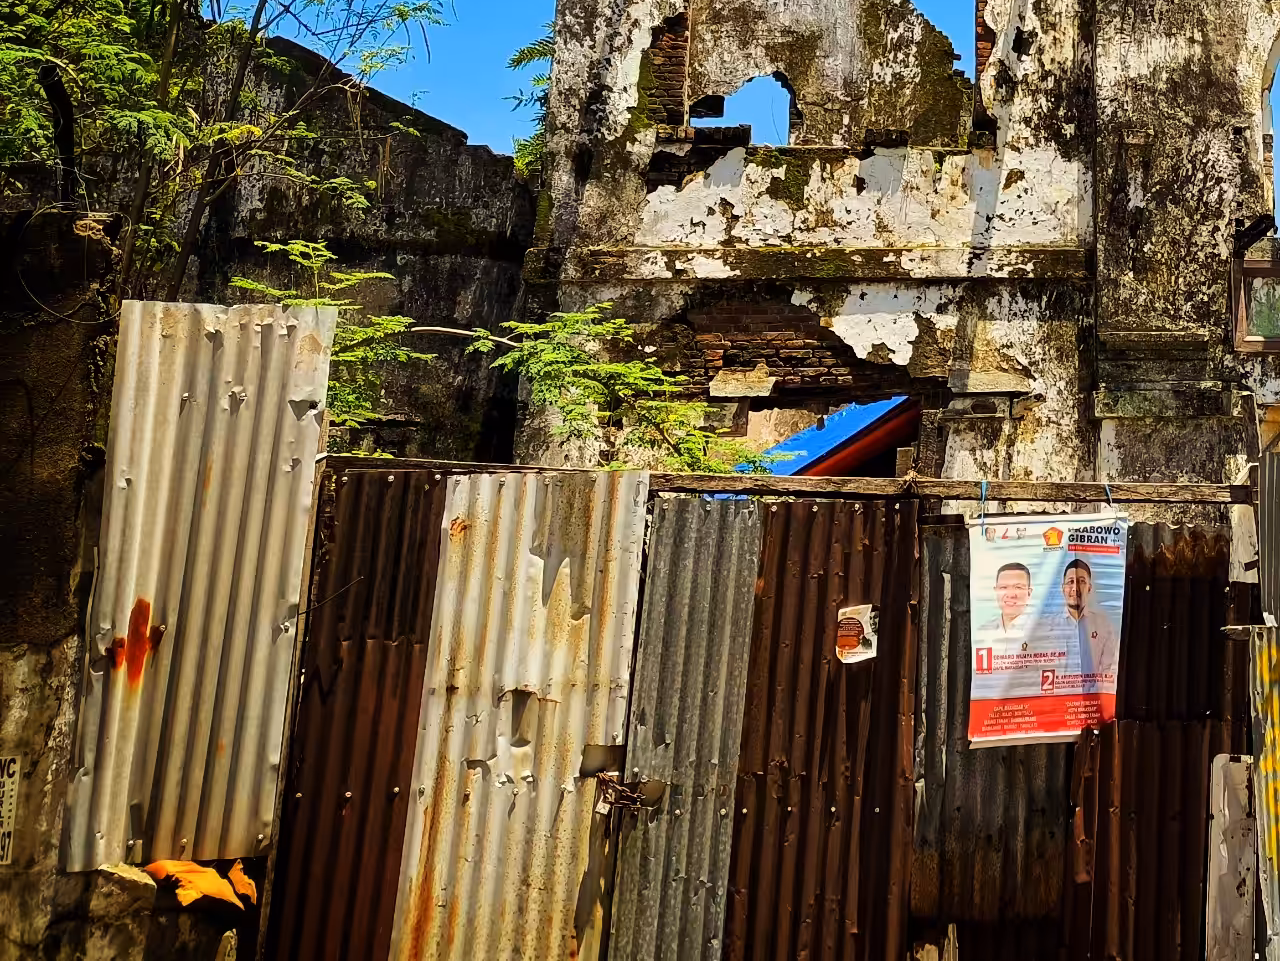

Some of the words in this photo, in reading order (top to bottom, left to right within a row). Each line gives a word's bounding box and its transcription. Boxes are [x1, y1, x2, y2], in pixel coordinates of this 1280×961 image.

[1068, 534, 1108, 544] GIBRAN
[978, 648, 988, 670] 1
[1042, 671, 1054, 690] 2
